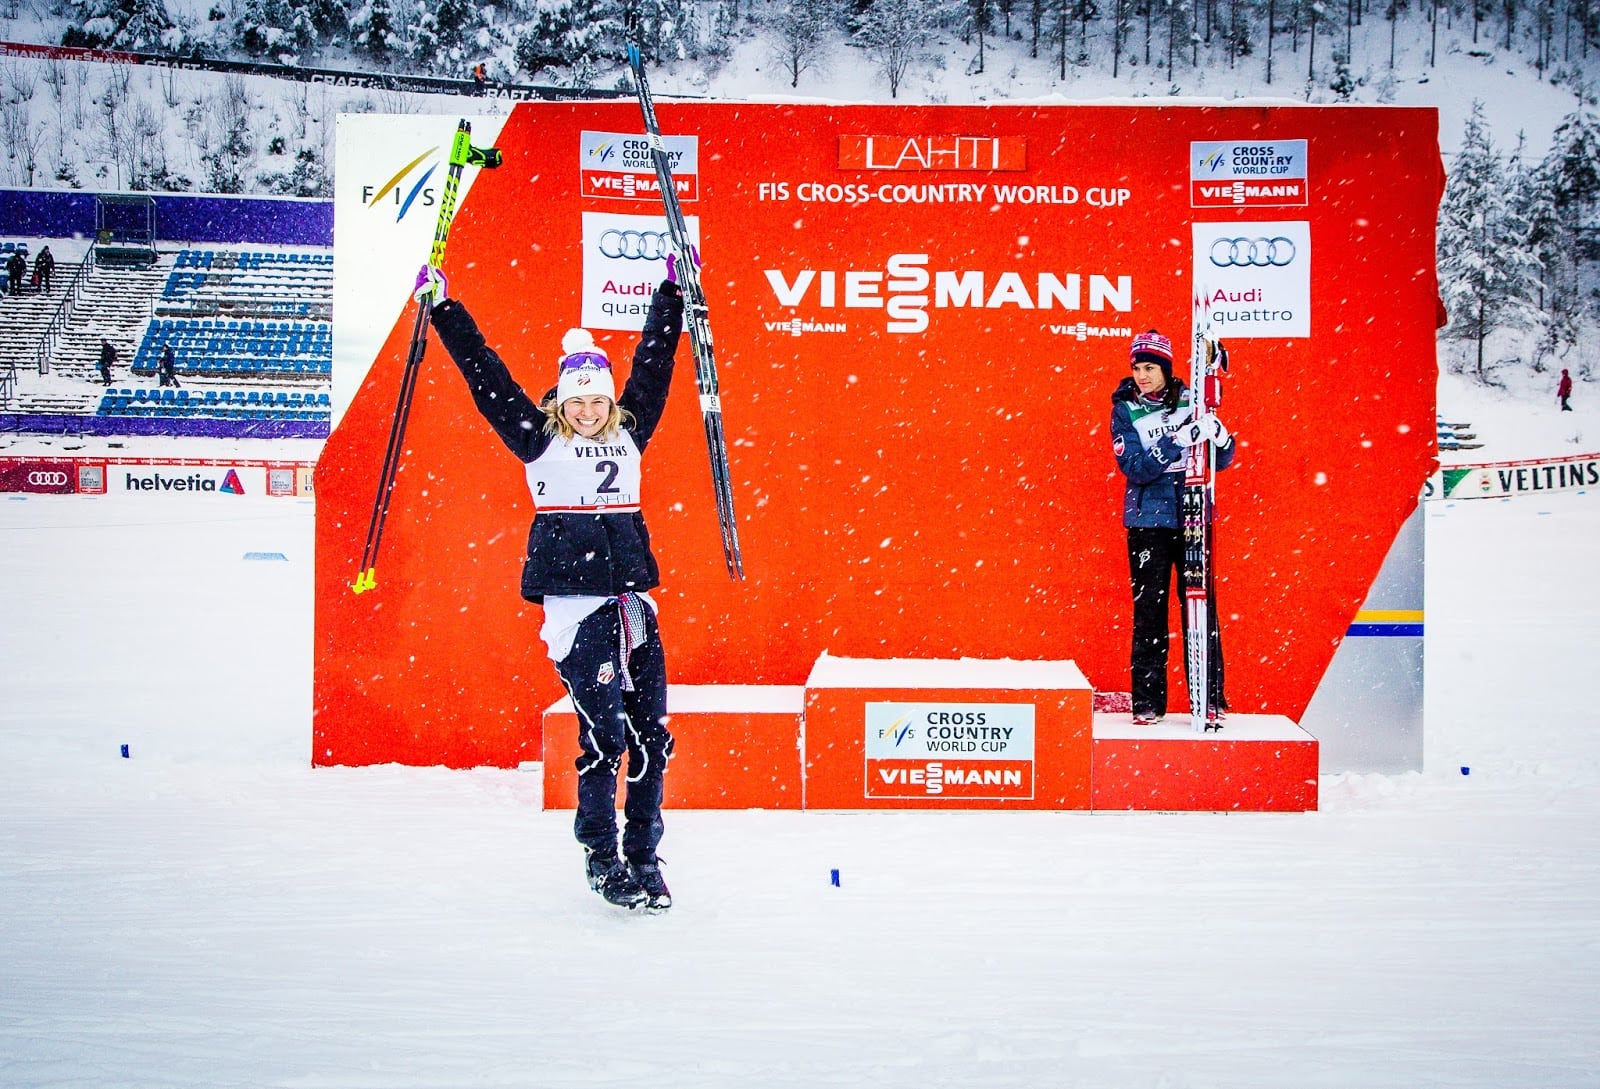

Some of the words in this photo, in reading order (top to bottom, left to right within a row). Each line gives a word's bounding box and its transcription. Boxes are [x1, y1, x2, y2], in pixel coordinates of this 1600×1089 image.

[623, 140, 649, 150] CRO
[866, 137, 1000, 169] LAHTI
[1233, 146, 1274, 156] CROSS
[623, 150, 684, 161] COURY
[1233, 155, 1293, 166] COUNTRY
[1233, 166, 1268, 175] WORLD
[1270, 166, 1289, 174] CUP
[590, 174, 689, 197] VIESSMAN
[1199, 181, 1299, 204] VIESSMANN
[362, 185, 435, 206] FIS
[759, 182, 790, 202] FIS
[797, 182, 987, 204] CROSS-COUNTRY
[994, 185, 1079, 205] WORLD
[1085, 187, 1132, 207] CUP
[602, 279, 652, 296] Audi
[763, 253, 1132, 334] VIESSMANN
[1212, 288, 1262, 302] Audi
[601, 302, 650, 317] quat
[1212, 309, 1293, 326] quattro
[764, 317, 847, 337] VIESSMANN
[1049, 322, 1132, 342] VIESSMANN
[574, 445, 628, 458] VELTINS
[126, 472, 216, 492] helvetia
[595, 460, 621, 494] 2
[1497, 461, 1600, 493] VELTINS
[536, 481, 546, 496] 2
[580, 493, 631, 505] LAHTI
[926, 712, 986, 726] CROSS
[878, 729, 915, 739] FIS
[926, 726, 1014, 740] COUNTRY
[926, 741, 977, 752] WORLD
[981, 741, 1008, 752] CUP
[878, 762, 1022, 794] VIESSMANN
